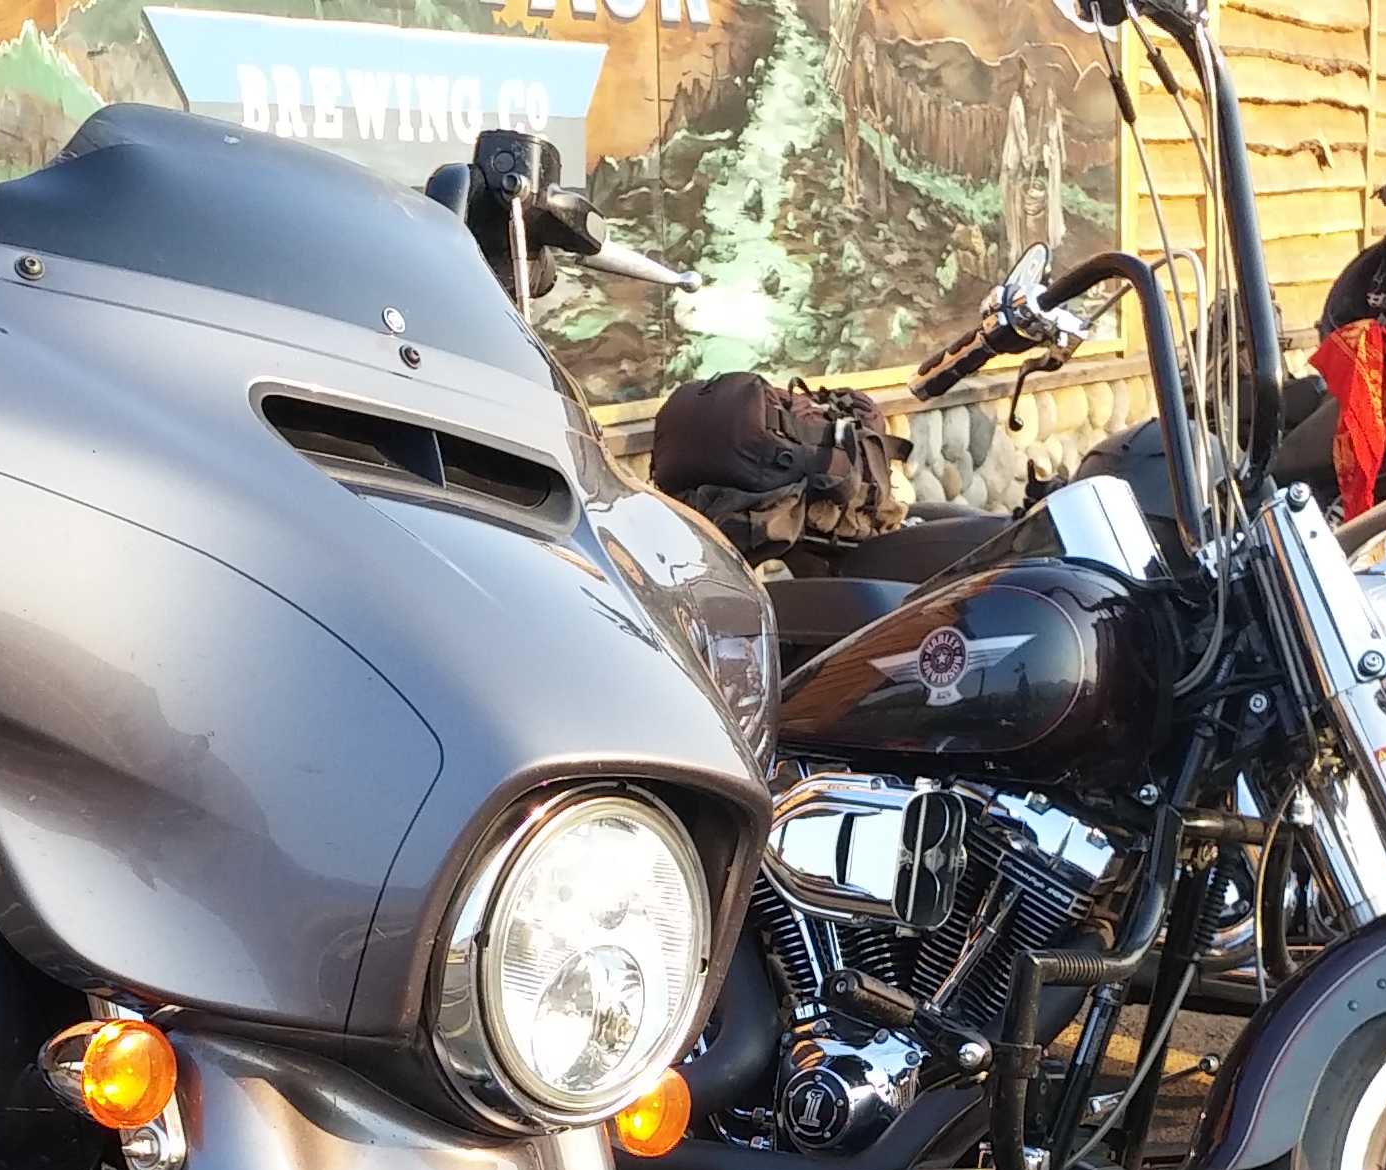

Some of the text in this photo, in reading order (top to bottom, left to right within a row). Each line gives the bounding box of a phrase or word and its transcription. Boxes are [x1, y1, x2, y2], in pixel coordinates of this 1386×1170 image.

[237, 64, 483, 145] BREWING
[924, 633, 961, 654] HARLEY
[922, 655, 963, 684] DAVIDSON
